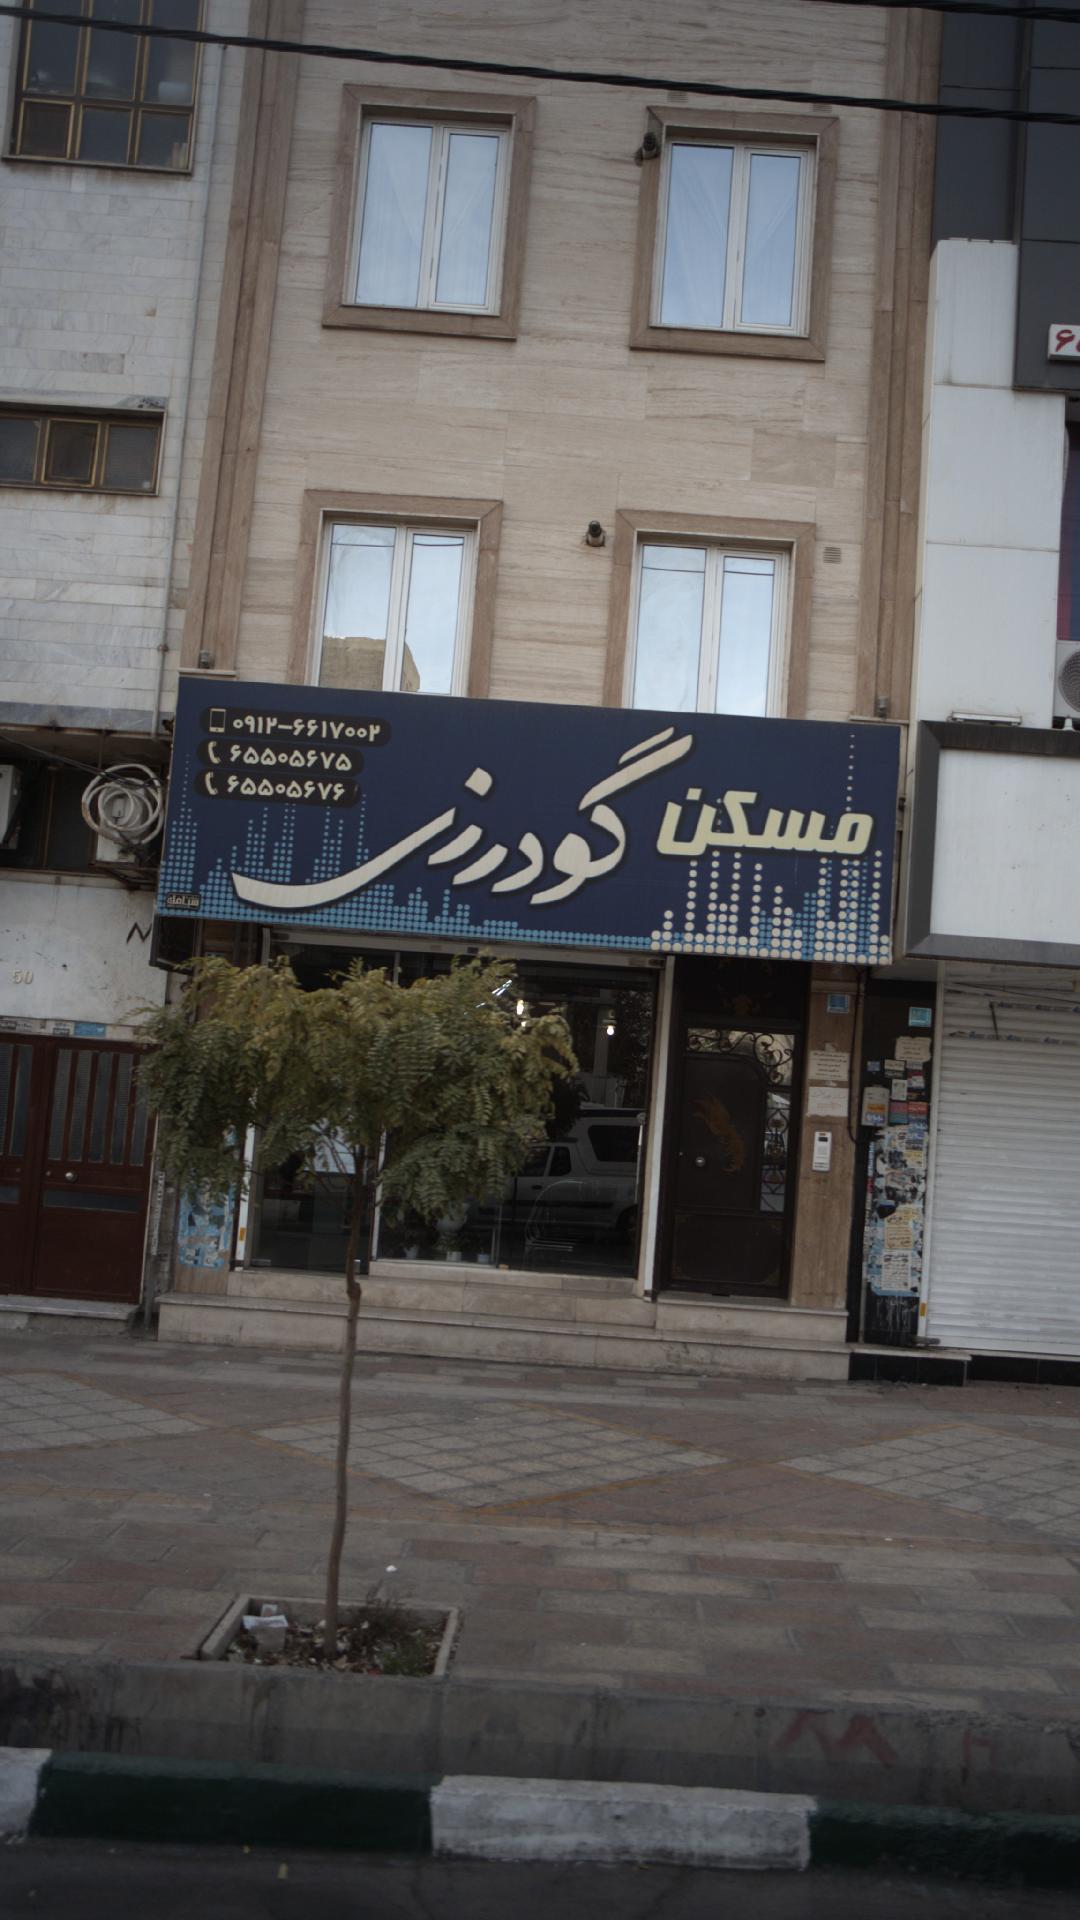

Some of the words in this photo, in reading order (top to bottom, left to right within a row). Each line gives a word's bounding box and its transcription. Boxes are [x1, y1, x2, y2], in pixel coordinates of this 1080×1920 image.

[232, 715, 381, 742] ۰۹۱۲-۶۶۱۷۰۰۲
[230, 744, 352, 771] ۶۵۵۰۵۶۷۵
[227, 775, 345, 801] ۶۵۵۰۵۶۷۶
[231, 726, 693, 909] گودرزی
[656, 787, 873, 856] مسکن
